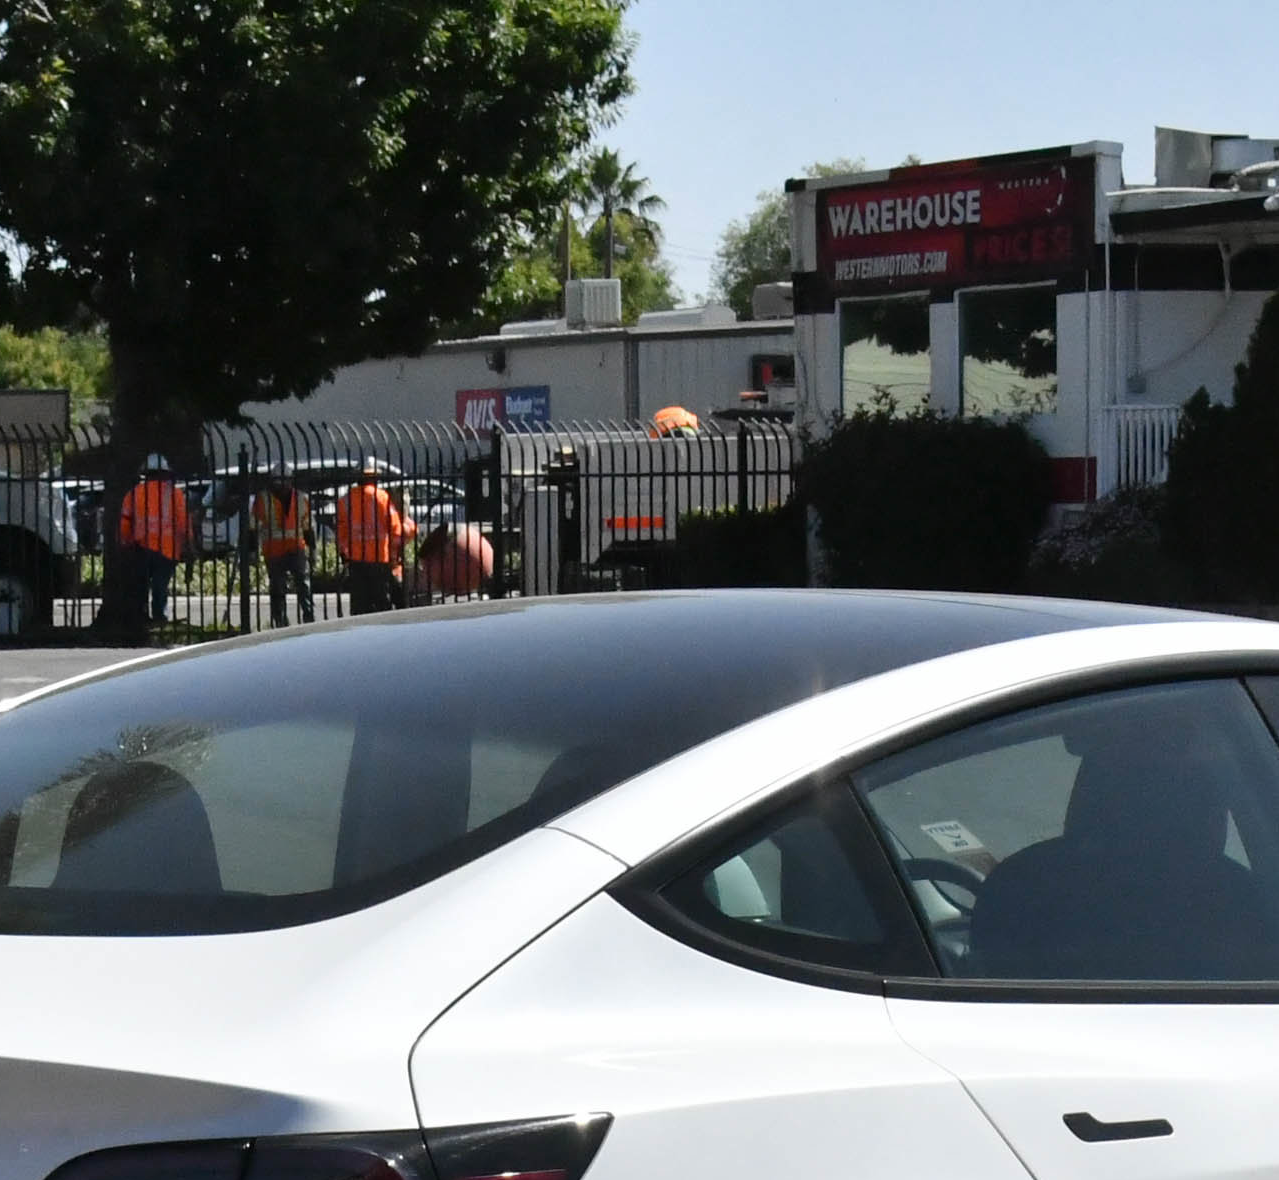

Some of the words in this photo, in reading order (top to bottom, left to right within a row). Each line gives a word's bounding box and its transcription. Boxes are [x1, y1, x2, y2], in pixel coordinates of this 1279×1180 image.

[829, 189, 981, 239] WAREHOUSE
[835, 251, 948, 281] WESTERNMOTORS.COM
[463, 398, 496, 429] AVIS
